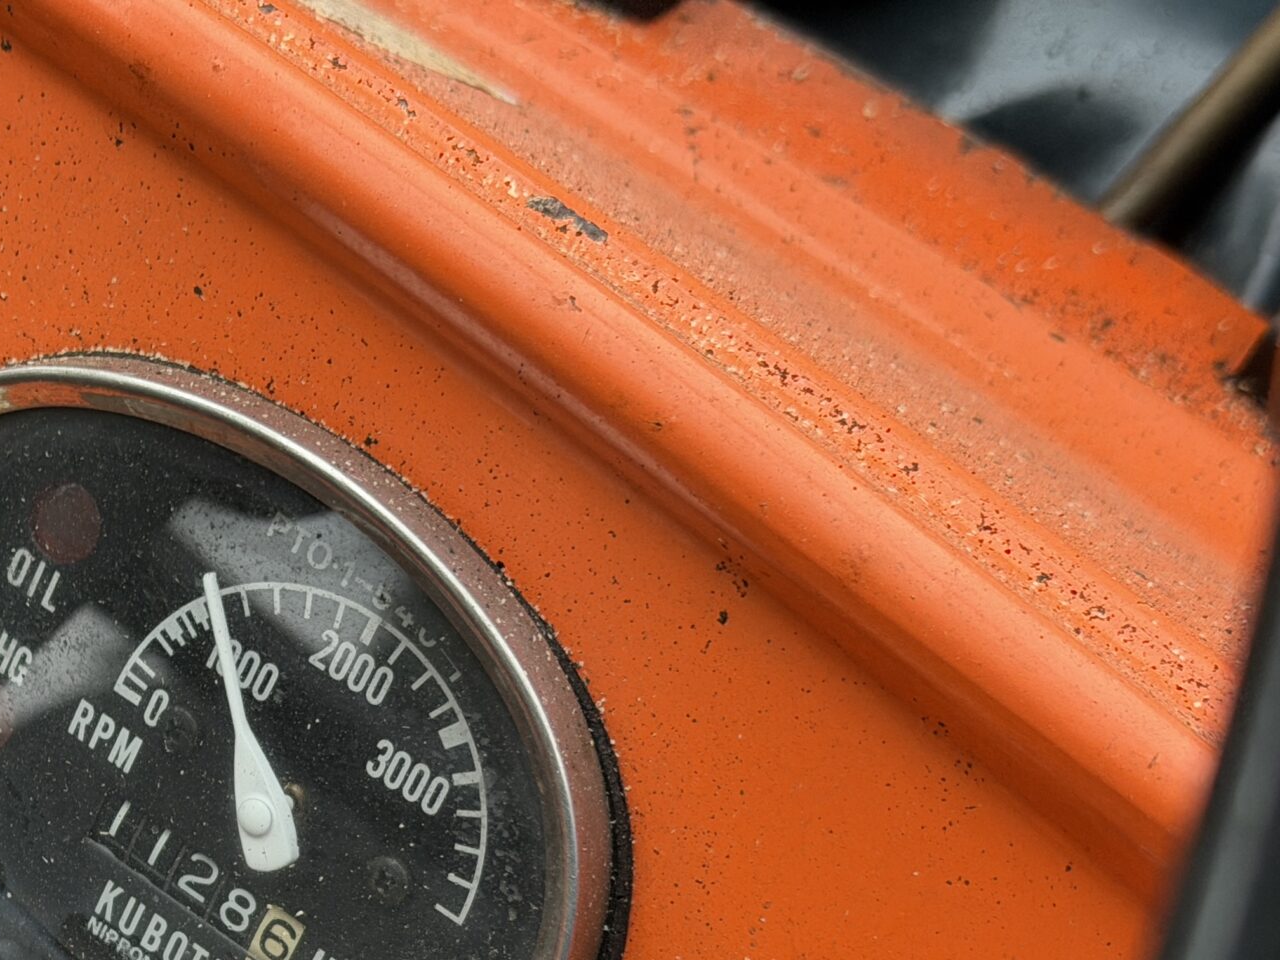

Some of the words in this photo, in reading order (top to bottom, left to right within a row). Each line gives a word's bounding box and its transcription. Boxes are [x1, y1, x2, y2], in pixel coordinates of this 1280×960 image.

[6, 547, 61, 613] OIL
[205, 639, 280, 701] 1000
[308, 629, 394, 706] 2000
[67, 699, 144, 774] RPM
[143, 688, 169, 727] 0
[365, 739, 450, 816] 3000
